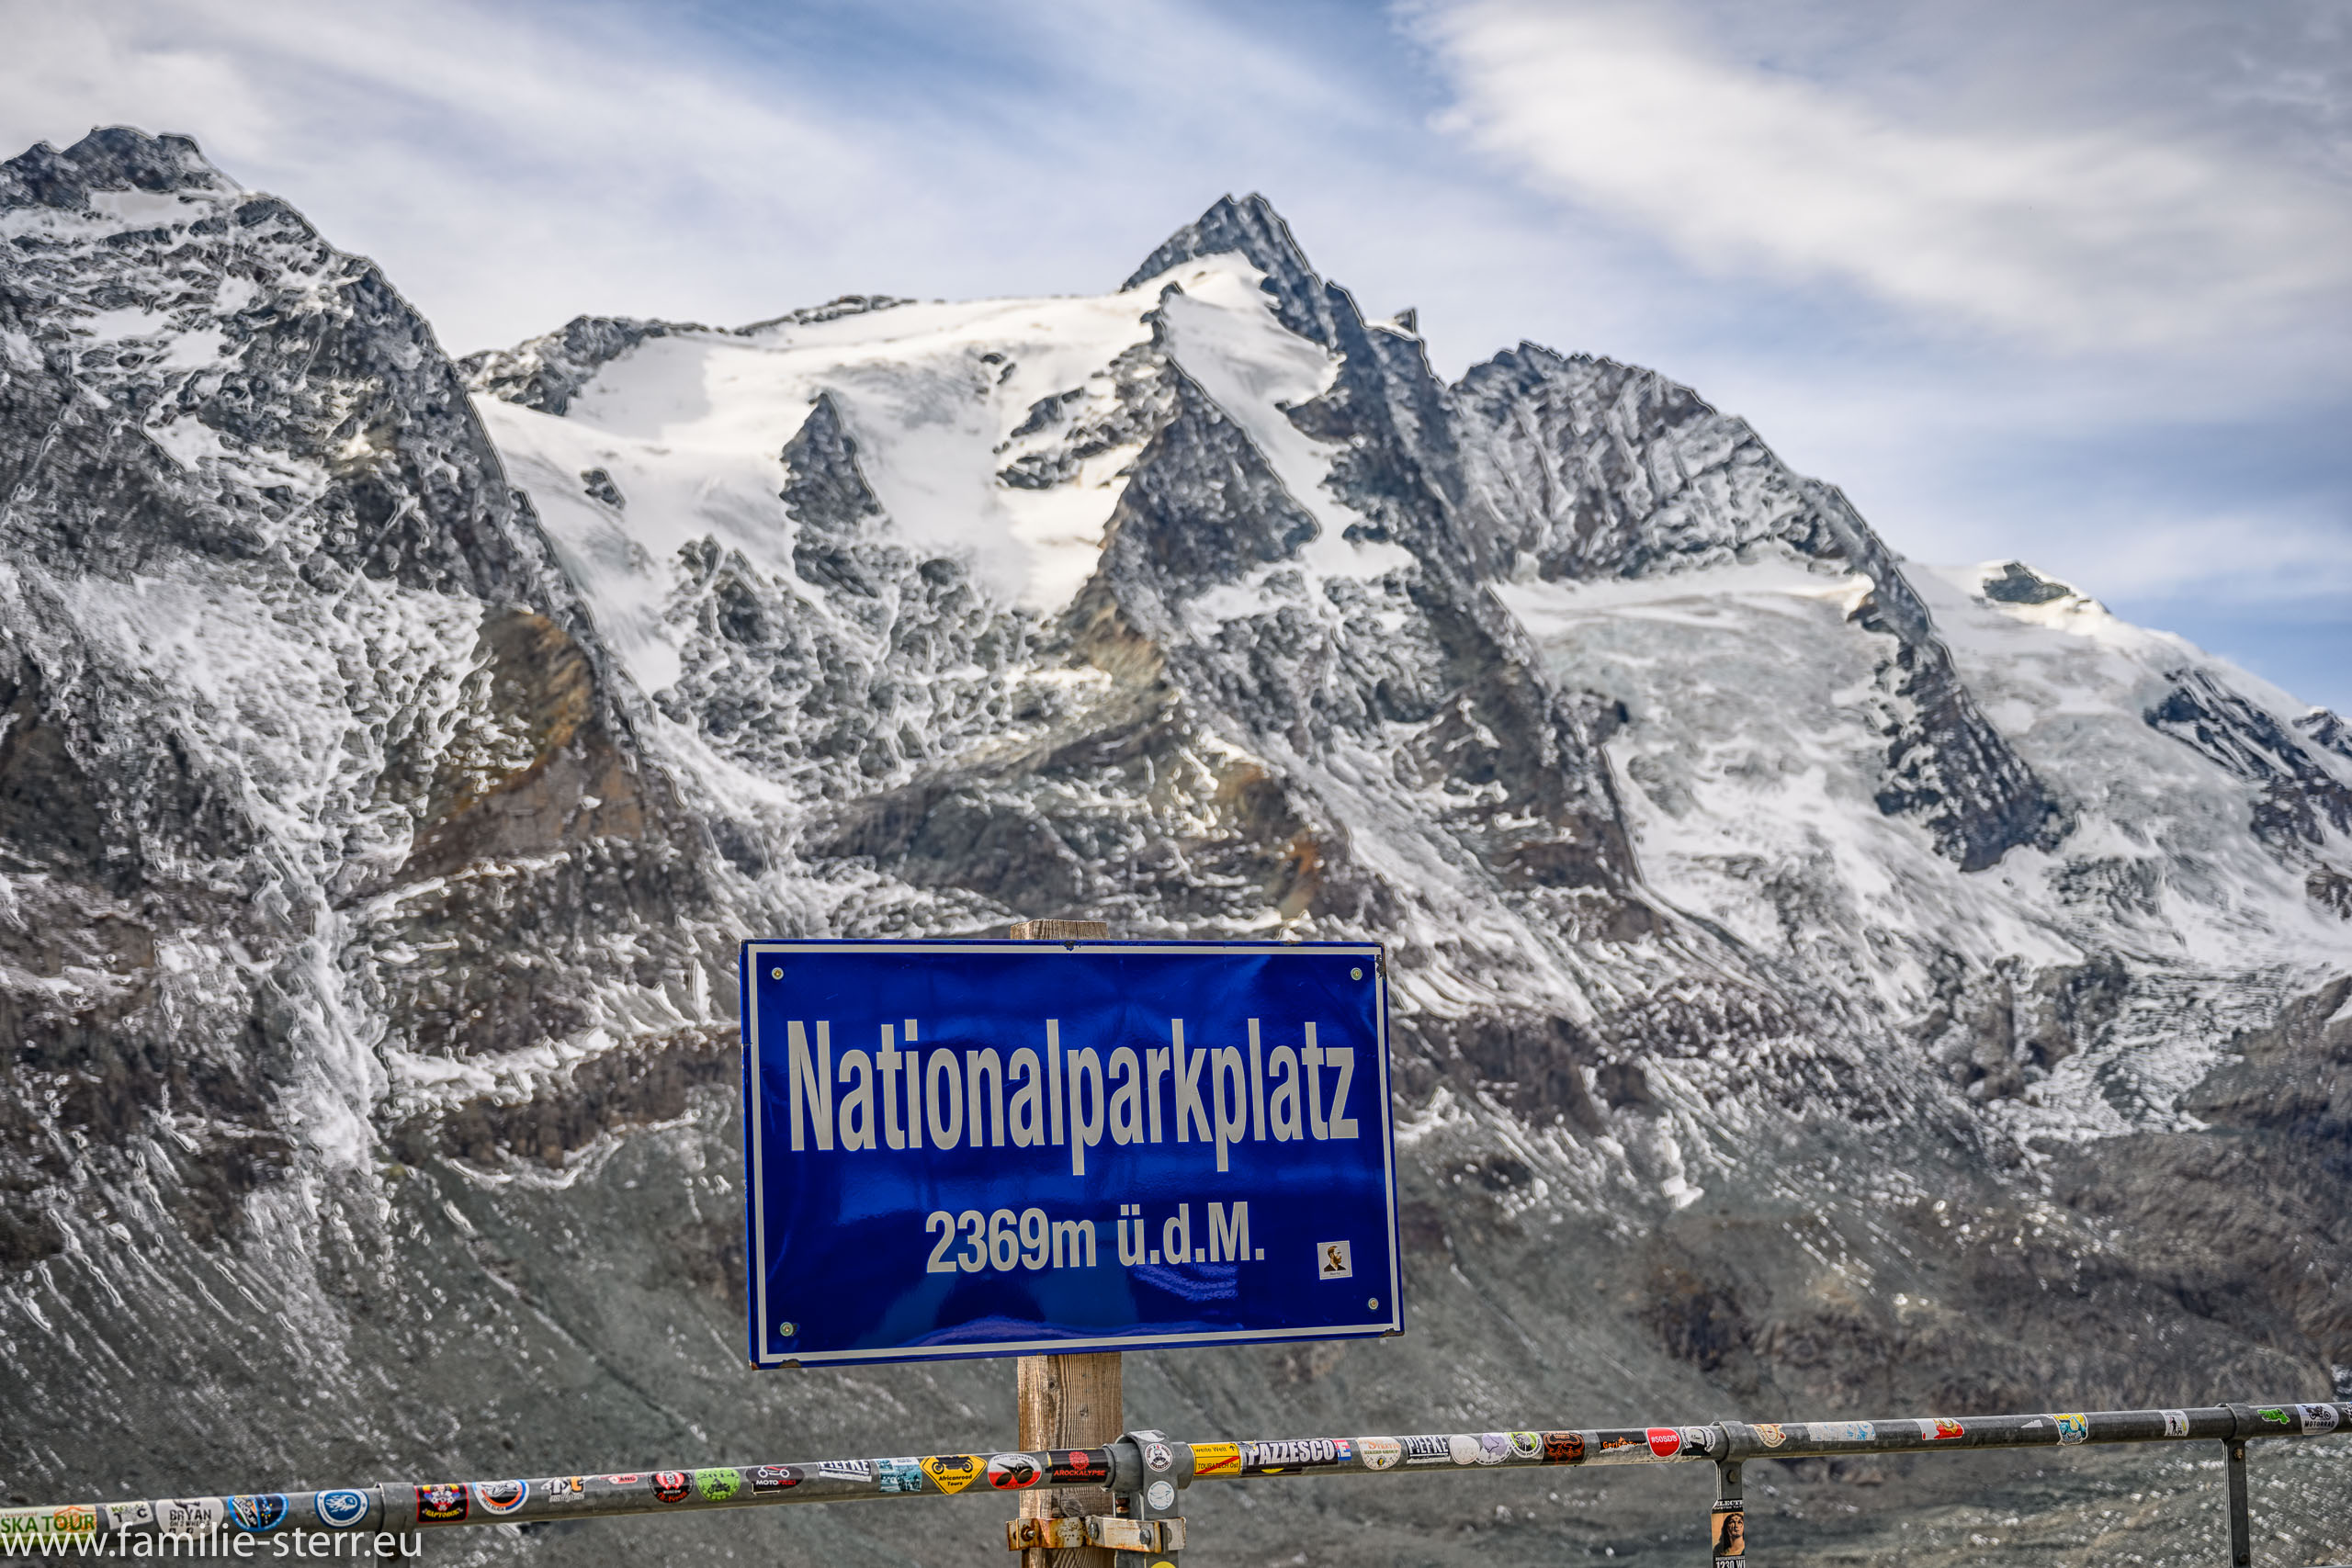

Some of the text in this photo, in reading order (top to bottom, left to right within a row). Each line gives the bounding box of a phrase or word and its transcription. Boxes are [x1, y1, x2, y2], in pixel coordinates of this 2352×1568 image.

[786, 1018, 1359, 1176] Nationalparkplatz
[925, 1201, 1265, 1273] 2369m ü.d.M.
[1247, 1439, 1336, 1466] PAZZESCO
[40, 1513, 96, 1532] TOUR
[169, 1508, 212, 1522] BRYAN
